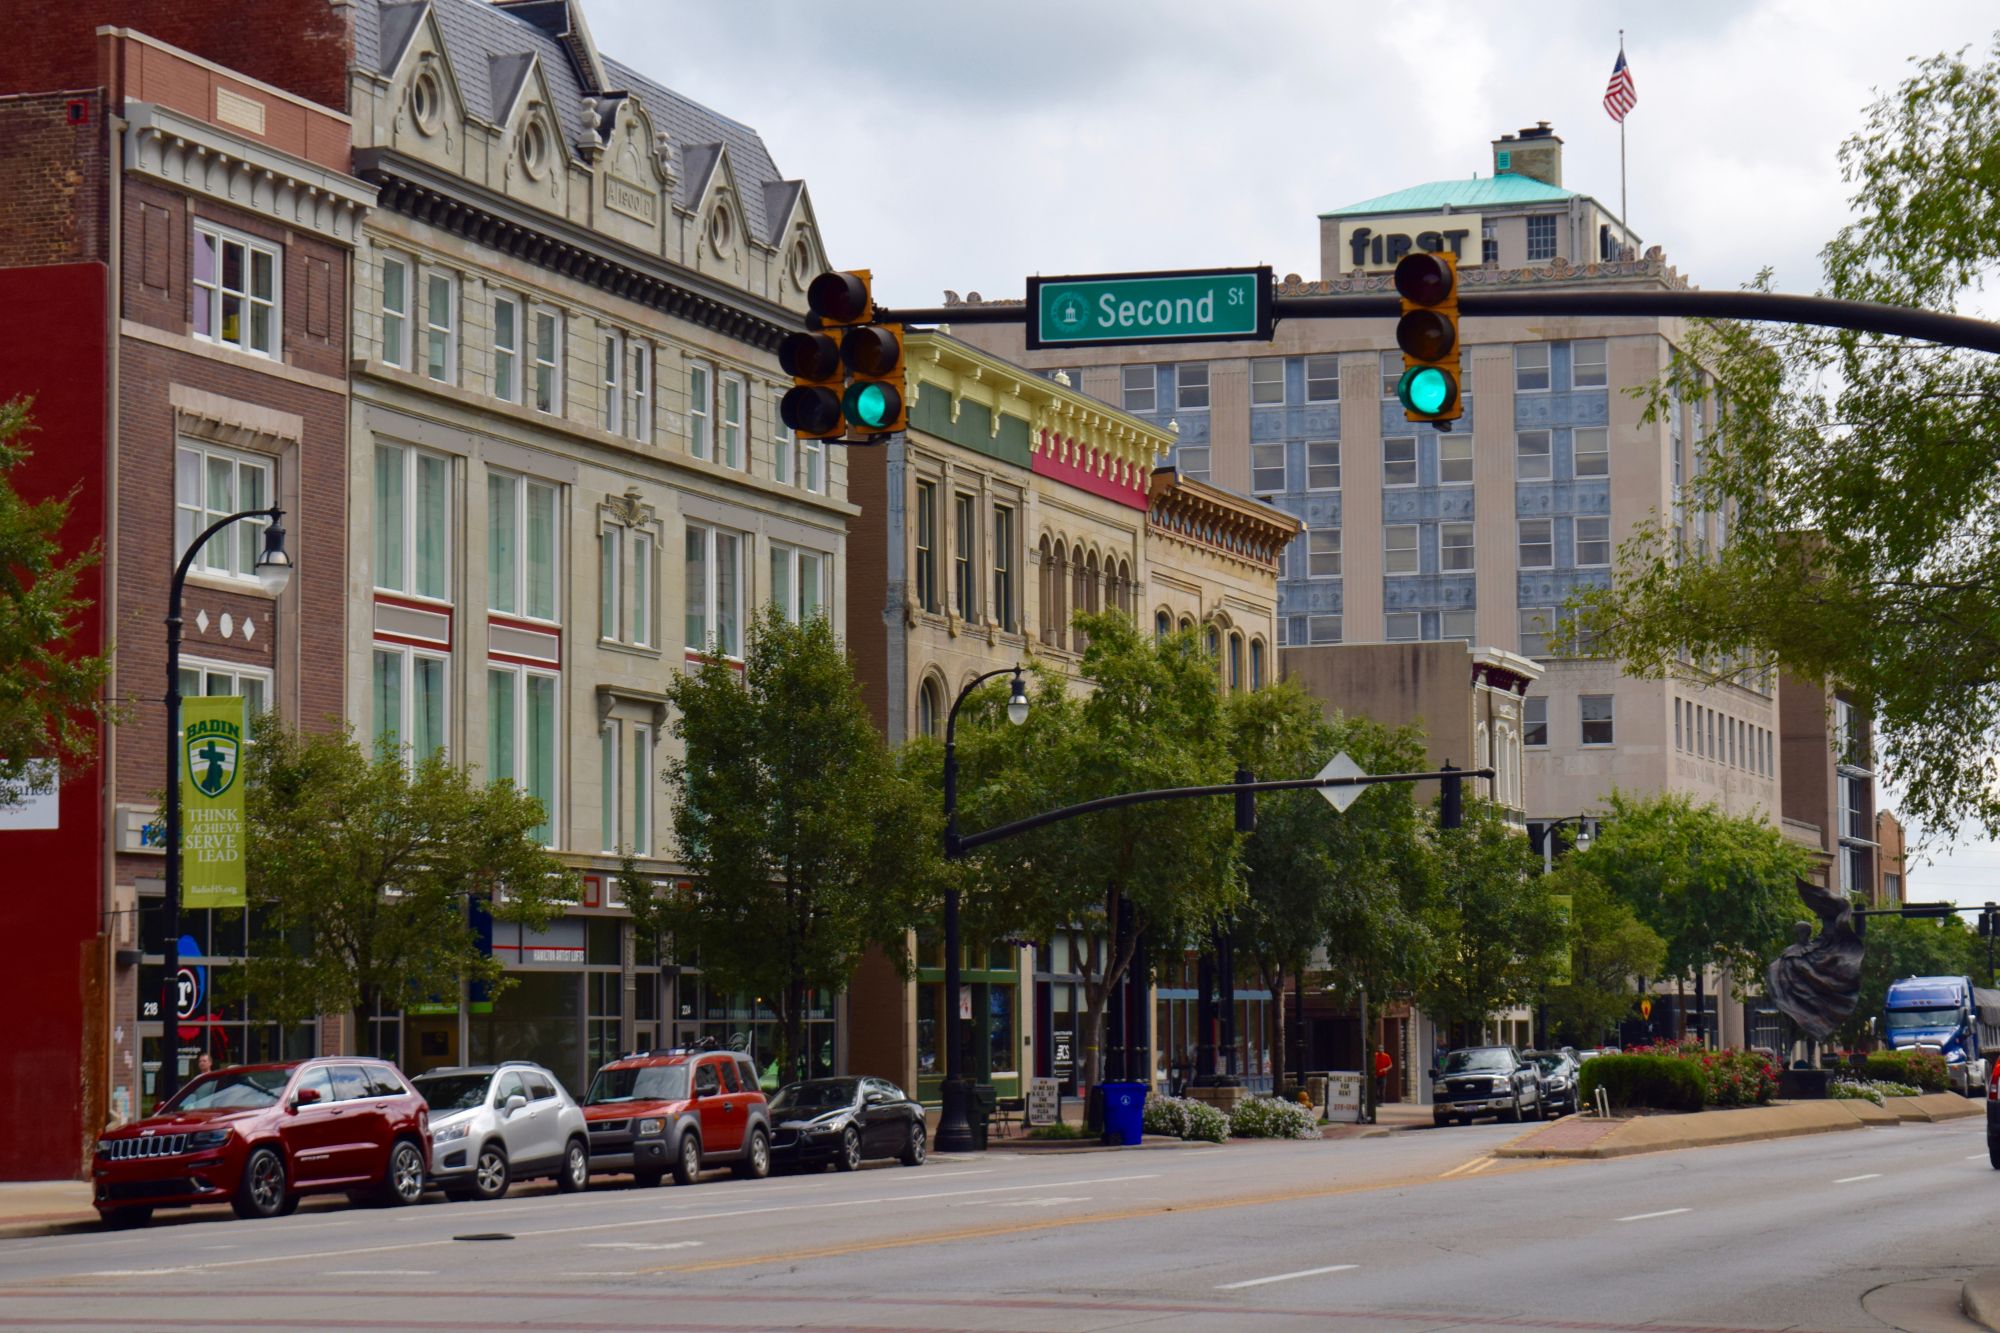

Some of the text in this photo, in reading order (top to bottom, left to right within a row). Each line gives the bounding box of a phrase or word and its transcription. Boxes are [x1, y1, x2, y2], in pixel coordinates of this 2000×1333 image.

[618, 187, 641, 211] 1900
[1097, 288, 1214, 328] Second
[1227, 287, 1245, 306] St
[187, 719, 240, 740] BADIN
[188, 808, 238, 822] THINK
[192, 822, 243, 834] ACHIEVE
[186, 834, 238, 849] SERVE
[198, 849, 239, 863] LEAD
[143, 1002, 159, 1016] 218
